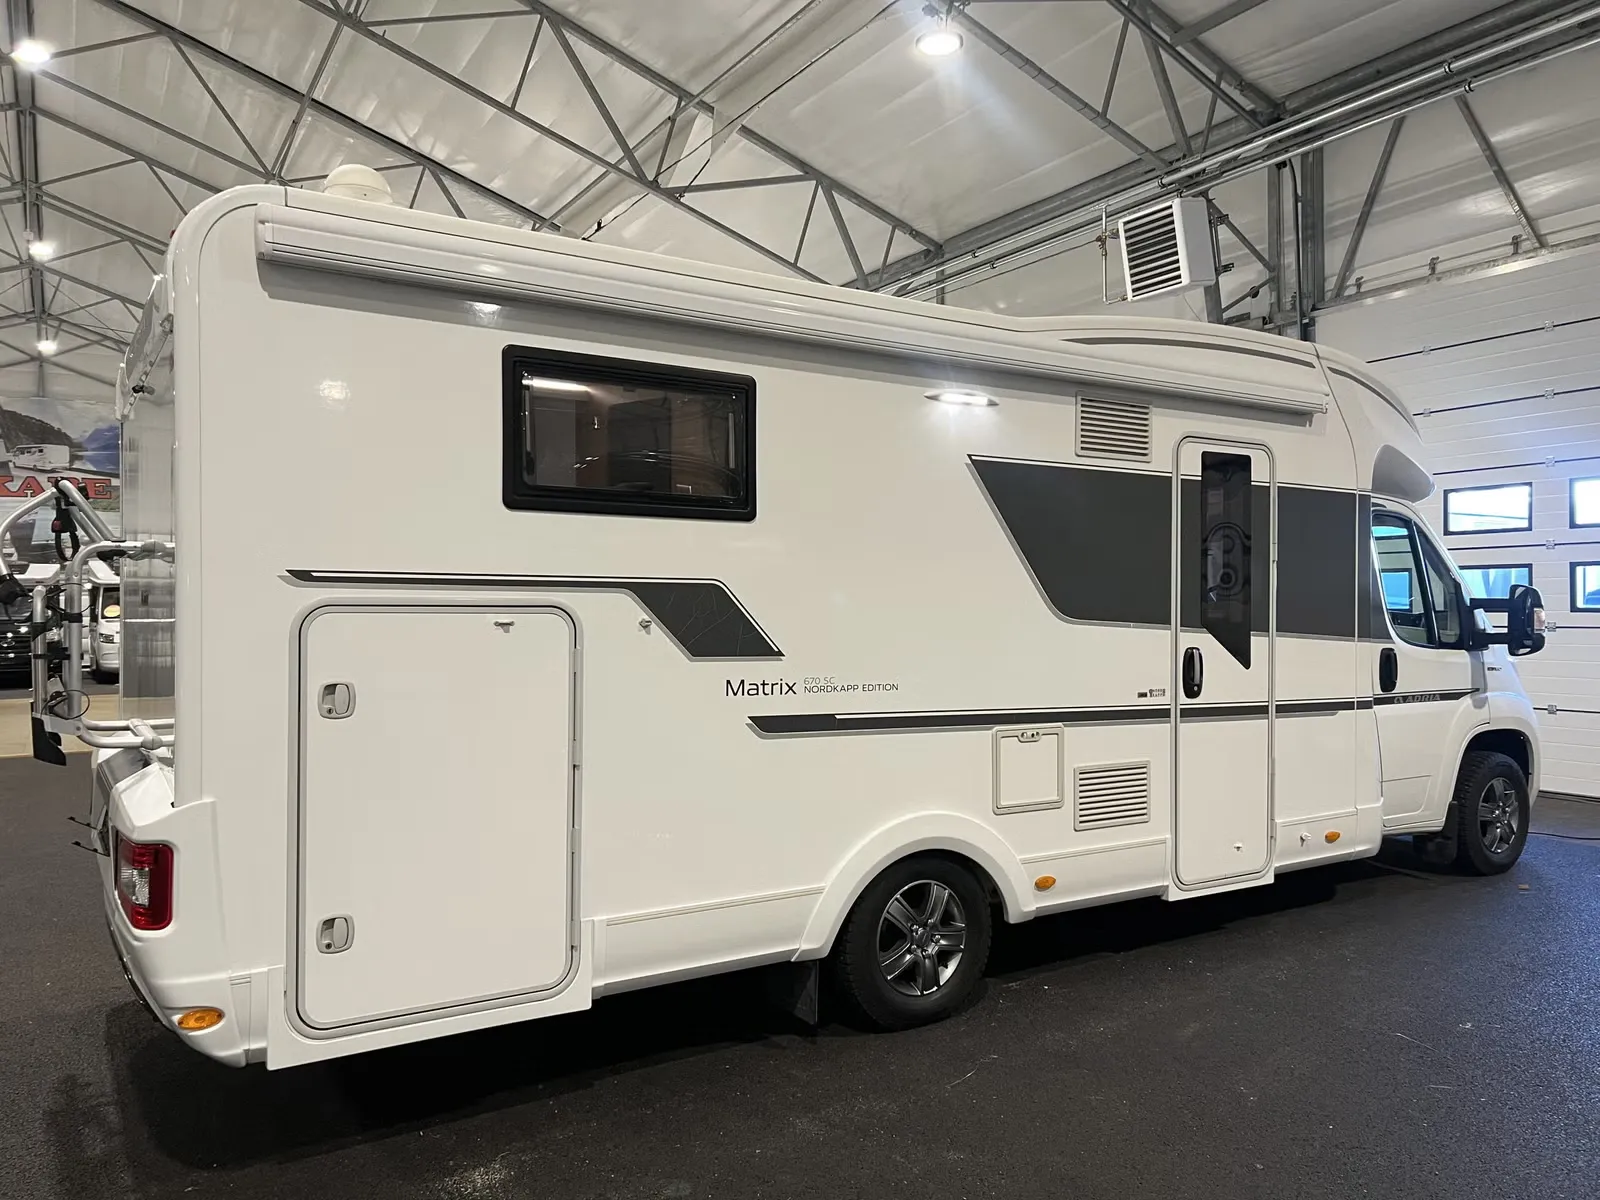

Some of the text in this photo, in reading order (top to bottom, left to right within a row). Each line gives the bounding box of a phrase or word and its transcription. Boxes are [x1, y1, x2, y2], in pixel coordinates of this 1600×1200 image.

[804, 677, 835, 685] 670 SC
[726, 678, 797, 697] Matrix
[804, 683, 899, 694] NORDKAPP EDITION
[1406, 694, 1440, 703] ADRIA
